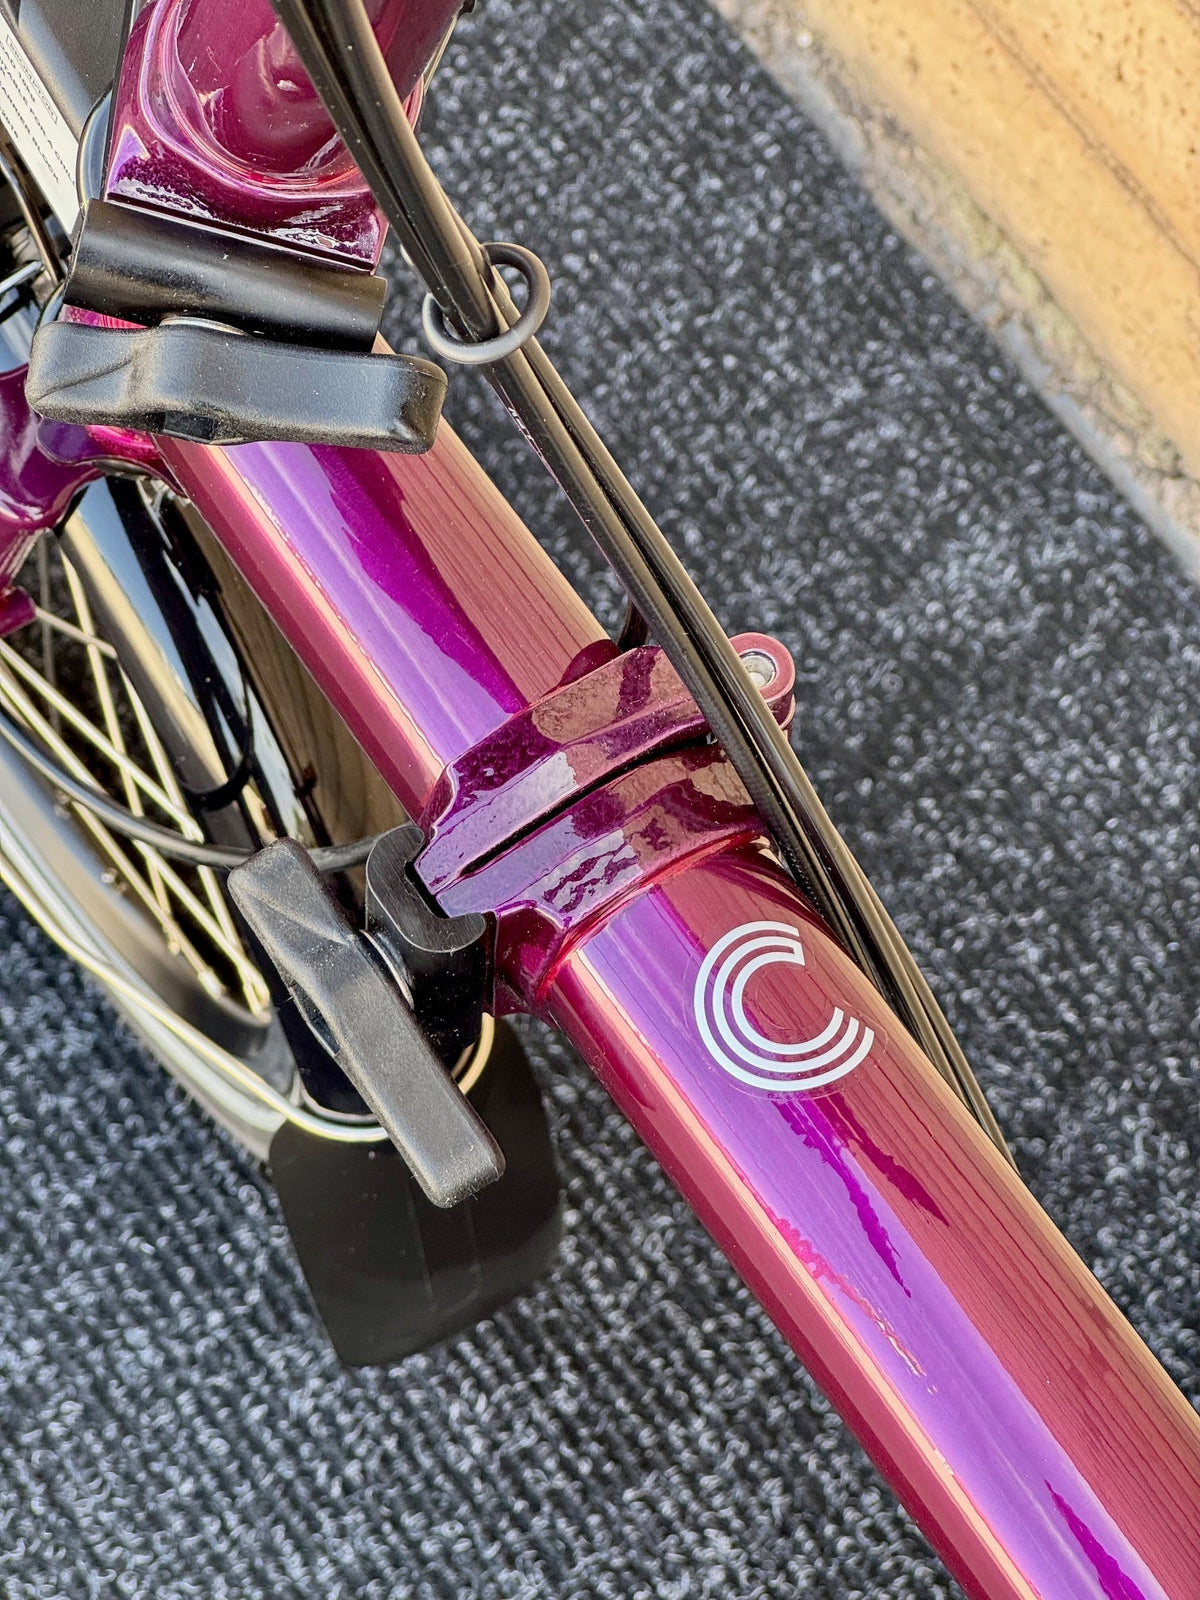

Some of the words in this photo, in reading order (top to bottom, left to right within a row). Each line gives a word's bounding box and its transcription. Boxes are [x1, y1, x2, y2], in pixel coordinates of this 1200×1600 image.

[0, 56, 28, 106] ITABLE
[30, 107, 46, 137] FOR
[0, 81, 31, 135] ARRIER
[32, 136, 60, 184] BLOCK
